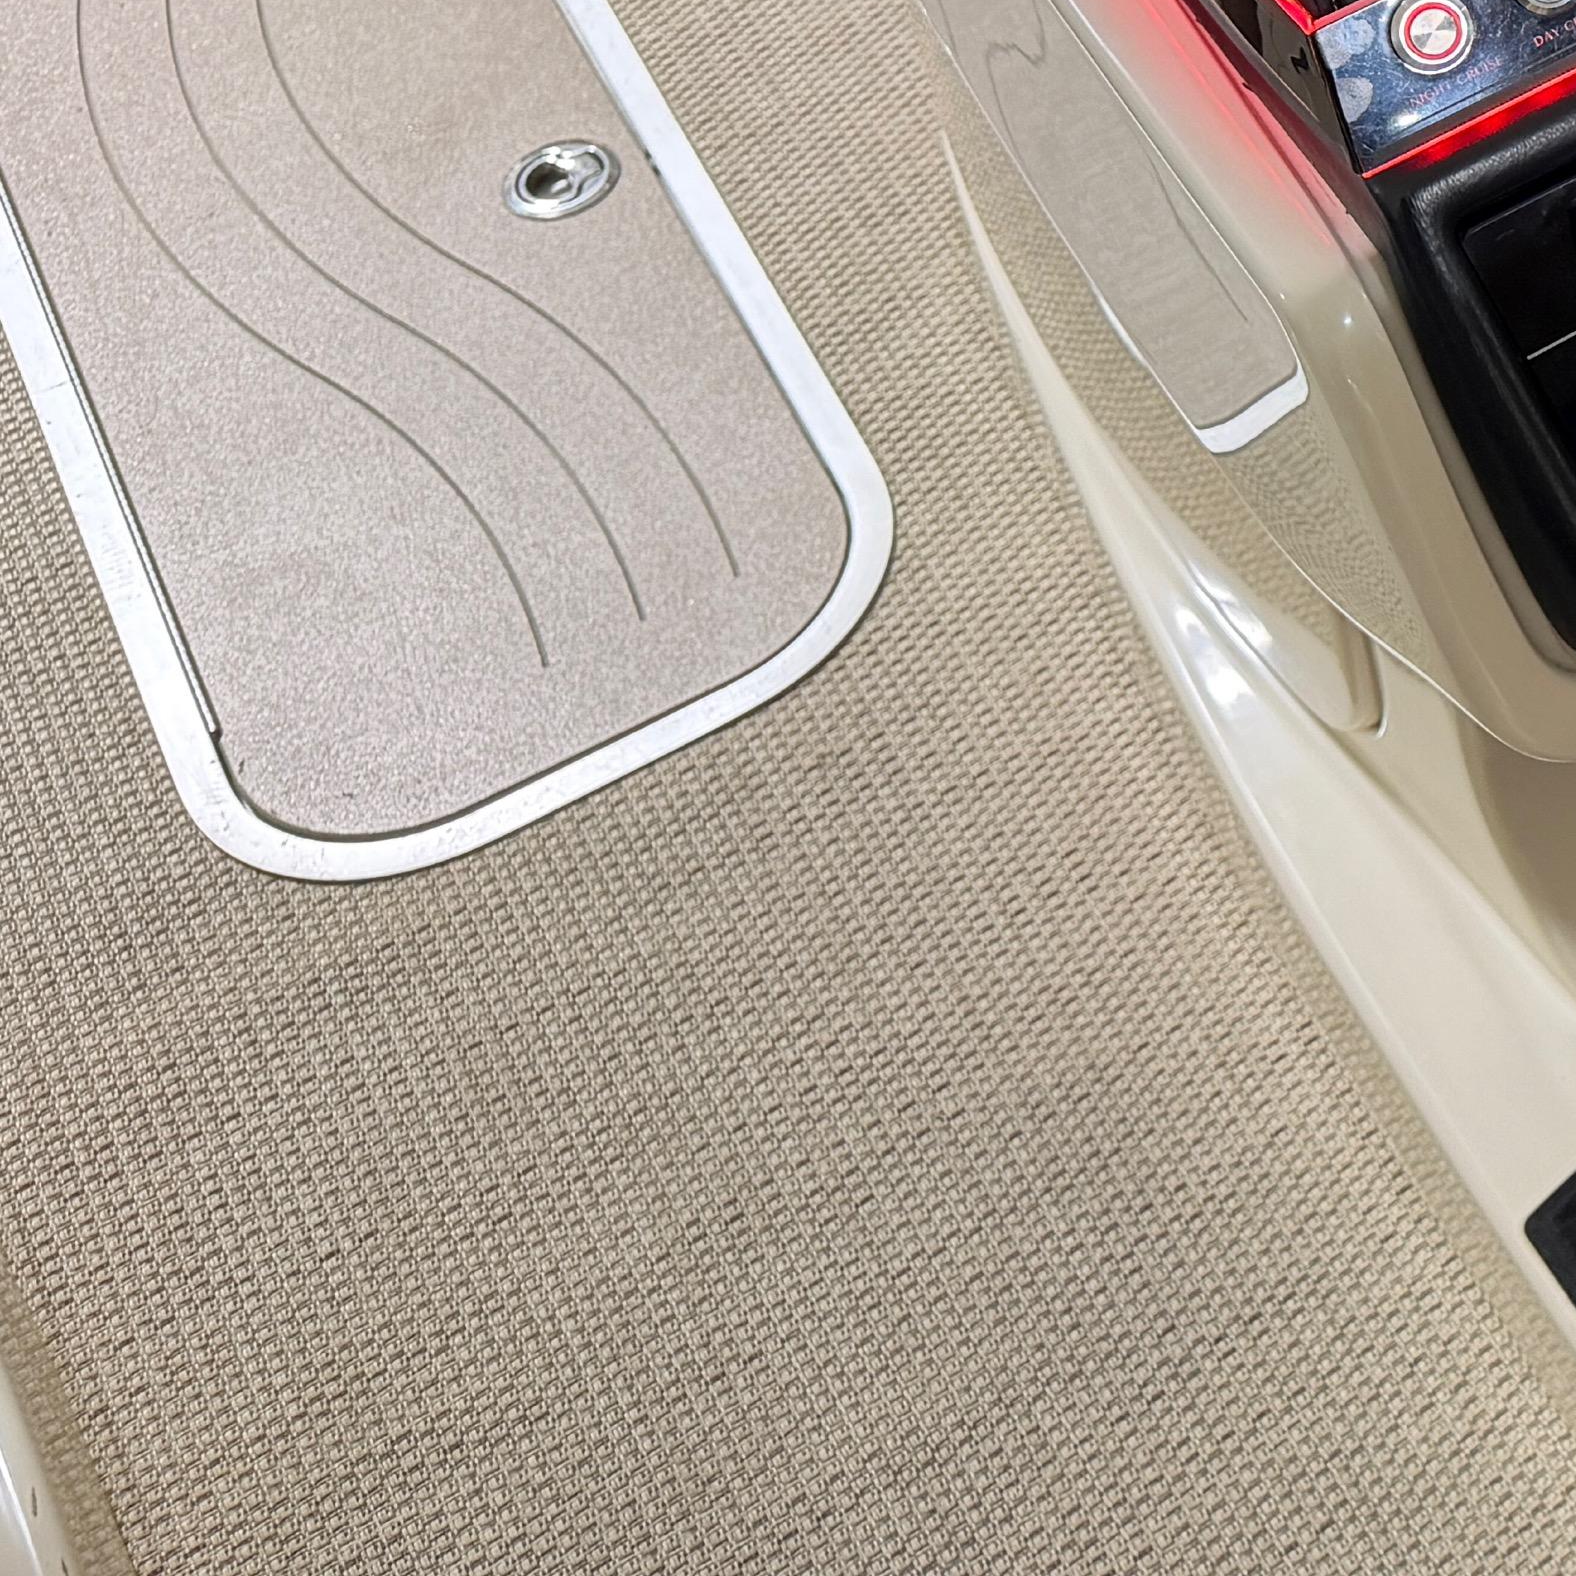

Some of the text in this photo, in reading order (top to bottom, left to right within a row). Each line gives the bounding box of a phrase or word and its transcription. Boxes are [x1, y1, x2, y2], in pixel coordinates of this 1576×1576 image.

[1534, 28, 1561, 48] DAY
[1409, 56, 1503, 109] NIGHT CRUISE
